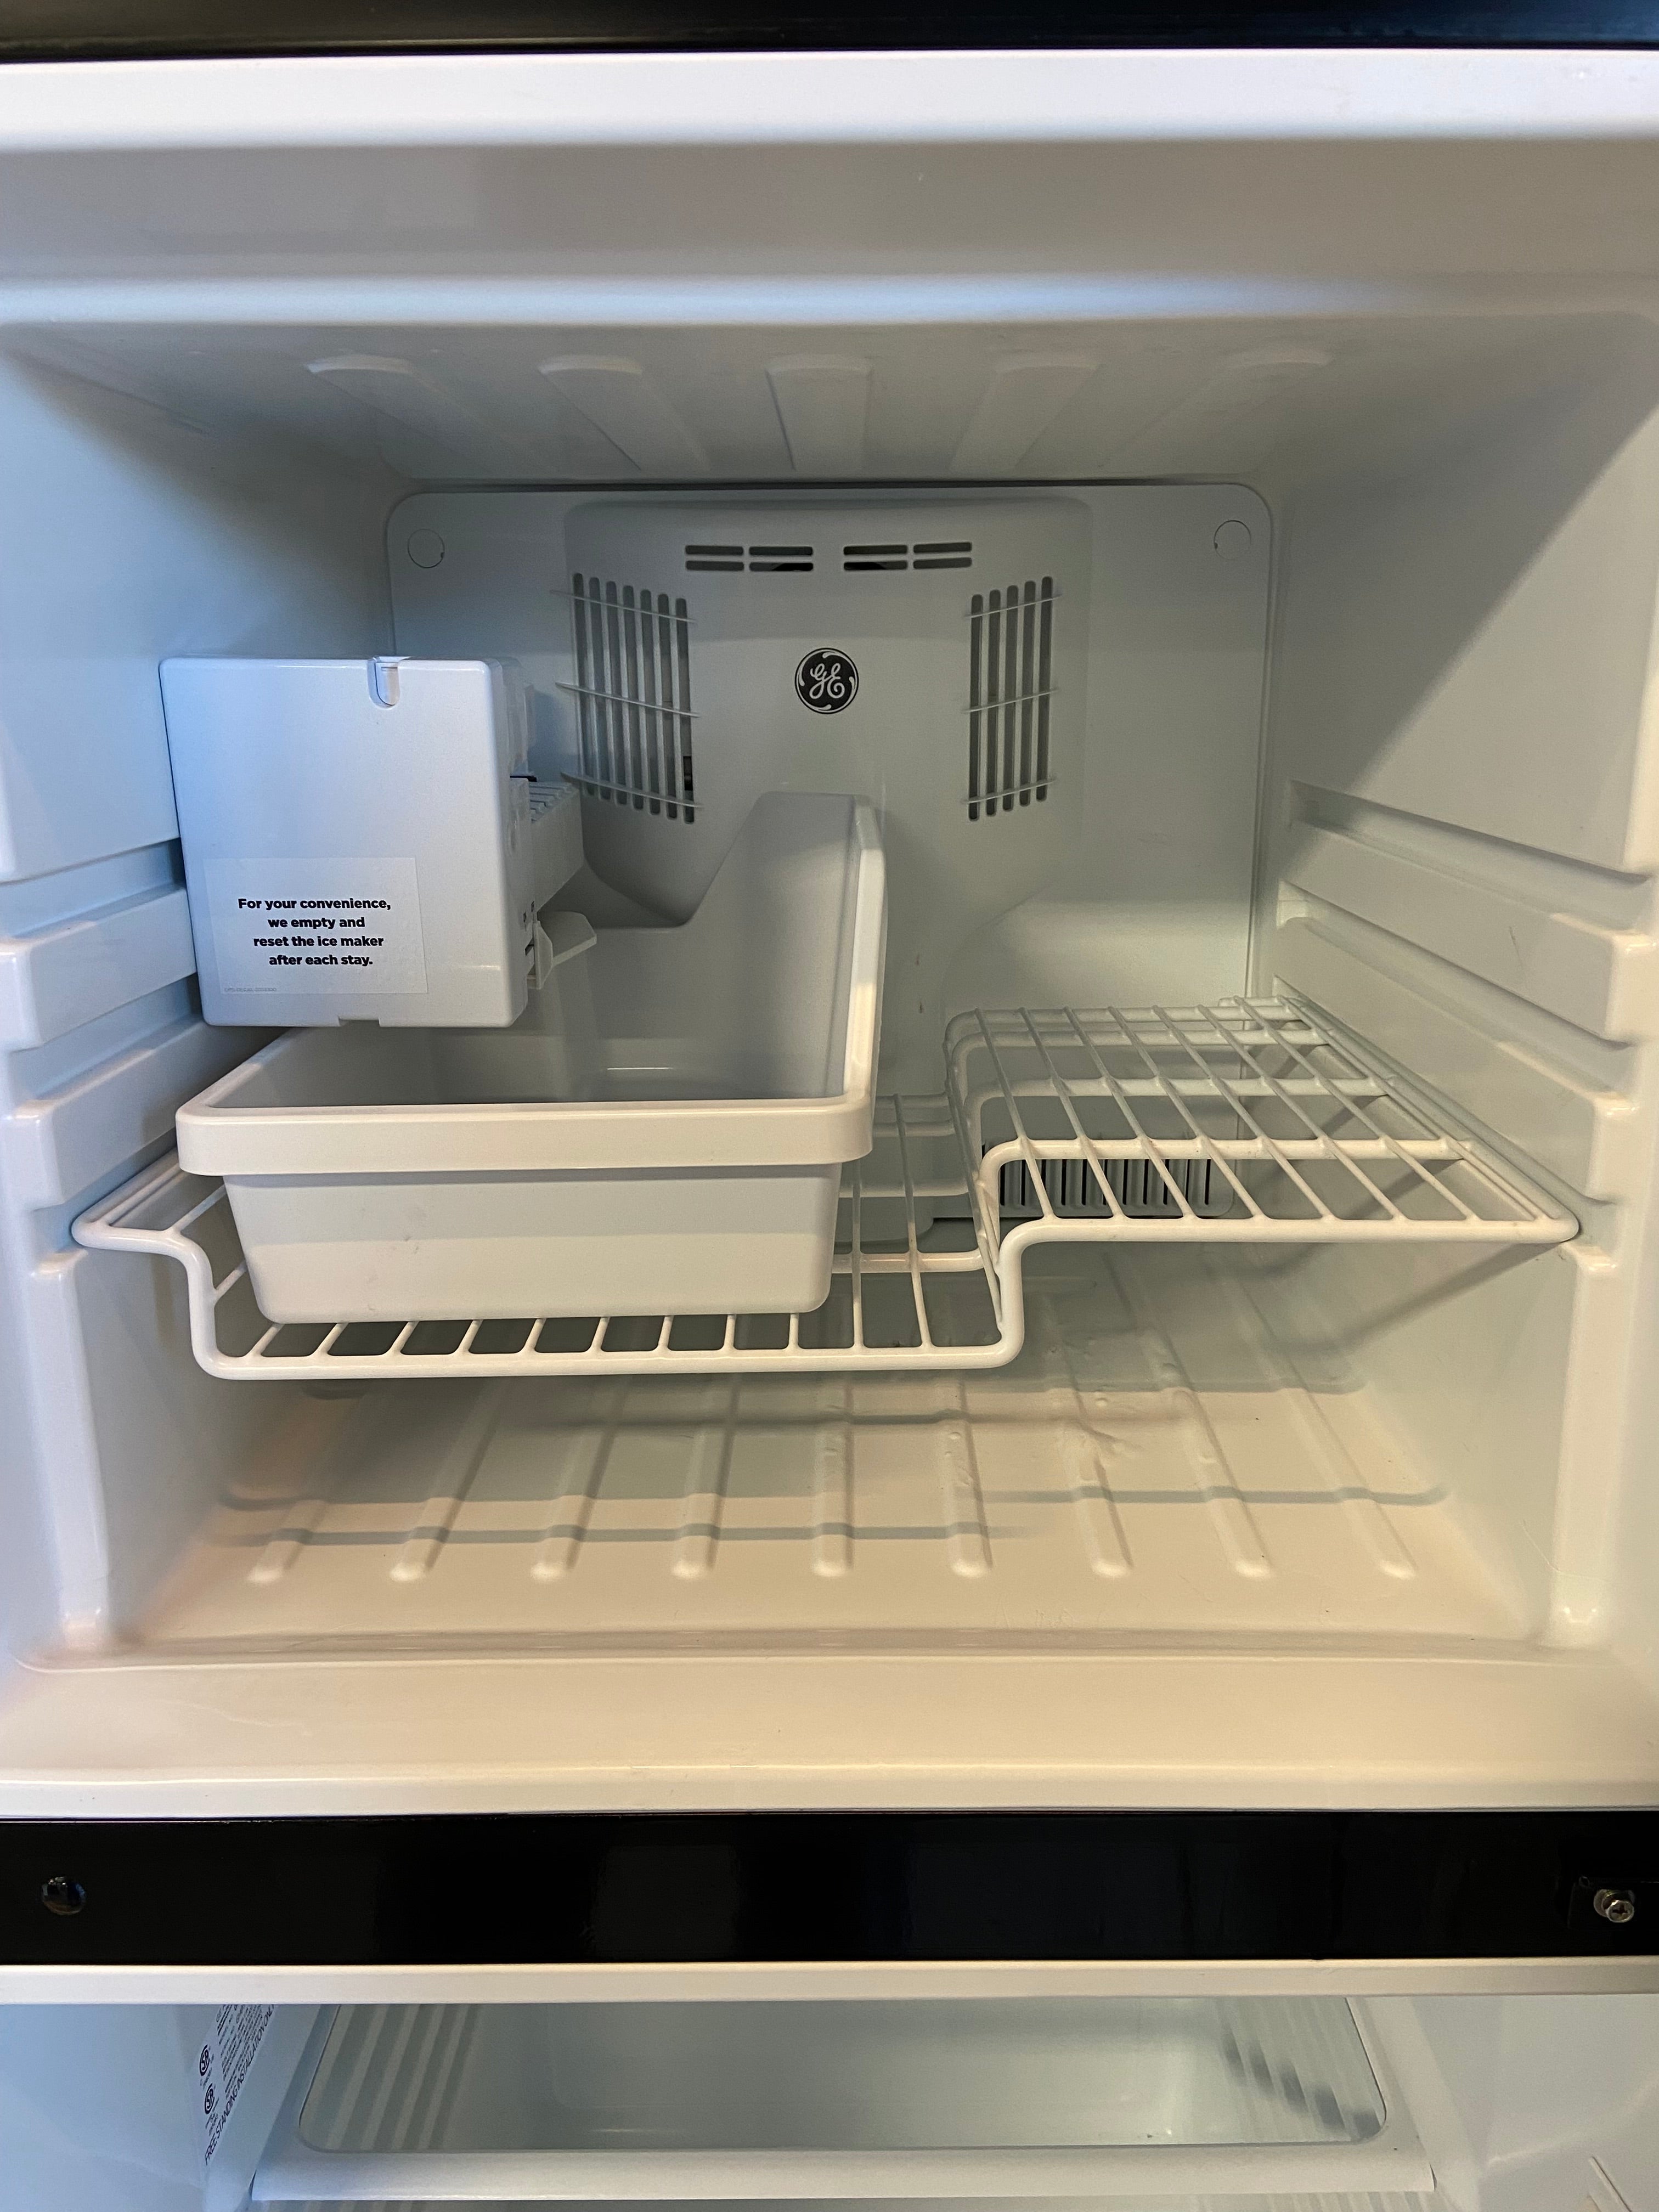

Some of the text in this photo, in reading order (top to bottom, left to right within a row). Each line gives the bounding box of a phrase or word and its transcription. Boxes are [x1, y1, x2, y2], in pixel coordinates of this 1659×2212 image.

[238, 898, 391, 911] For your convenience,
[268, 917, 365, 929] we empty and
[253, 935, 384, 947] reset the ice maker
[269, 955, 373, 967] after each stay.
[205, 2132, 217, 2166] FREE
[216, 2085, 238, 2139] STANDING
[237, 2022, 264, 2091] INSTALLATION
